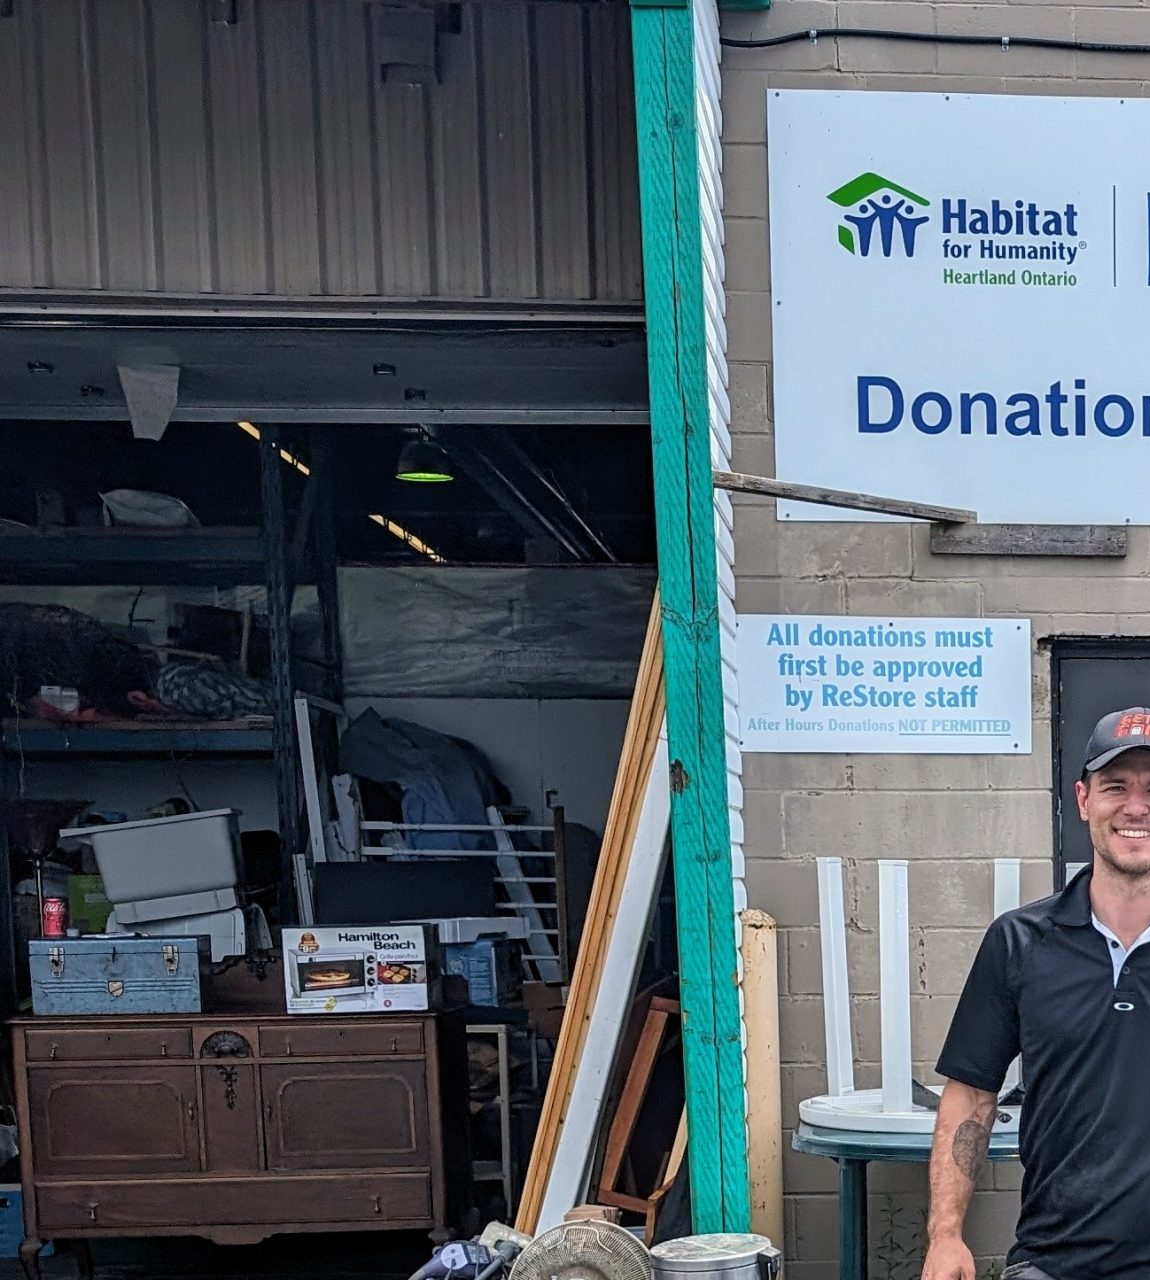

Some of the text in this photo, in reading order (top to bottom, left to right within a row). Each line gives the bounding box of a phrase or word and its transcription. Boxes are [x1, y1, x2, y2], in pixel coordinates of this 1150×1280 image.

[942, 199, 1078, 237] Habitat
[942, 239, 972, 260] for
[943, 269, 1077, 287] Heartland Ontario
[766, 623, 994, 649] All donations must
[778, 653, 983, 683] first be approved
[785, 683, 978, 711] by ReStore staff
[748, 717, 1012, 733] After Hours Donations NOT PERMITTED
[338, 933, 400, 943] Hamilton
[373, 940, 416, 950] Beach
